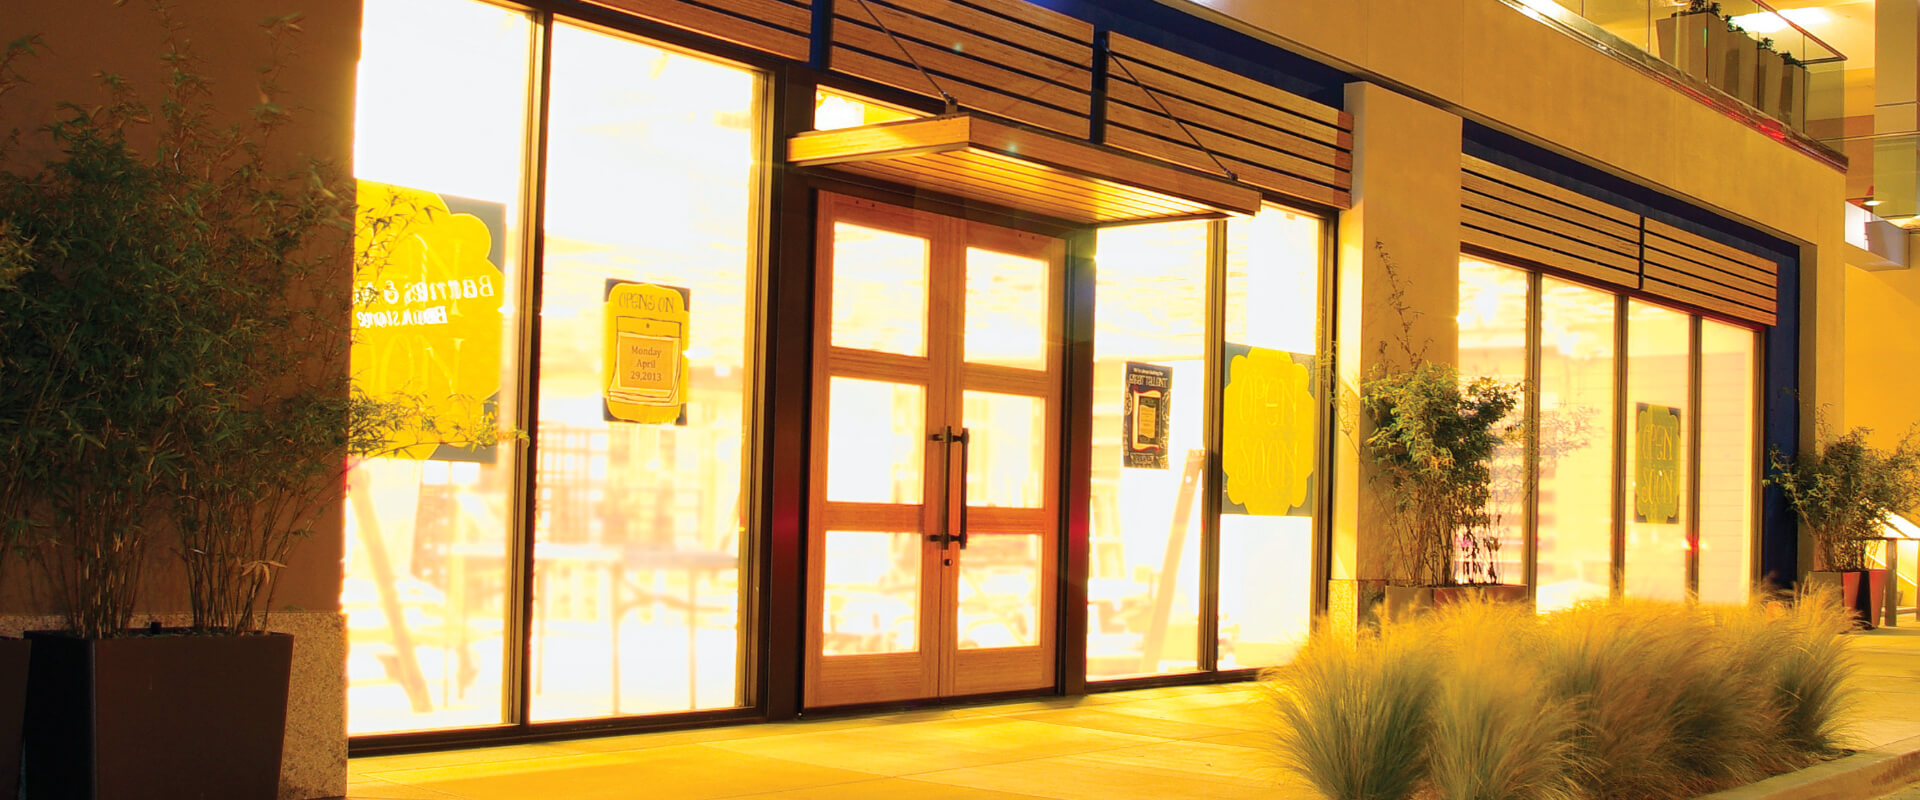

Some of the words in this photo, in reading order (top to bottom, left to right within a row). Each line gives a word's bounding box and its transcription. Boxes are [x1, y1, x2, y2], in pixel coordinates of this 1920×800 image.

[618, 292, 655, 311] OPENS
[657, 297, 674, 313] ON
[631, 346, 662, 358] Monday
[636, 359, 656, 369] April
[630, 370, 662, 381] 29,2013
[1239, 376, 1298, 425] OPEN
[1642, 423, 1673, 461] OPEN
[1236, 438, 1299, 489] SOON
[1641, 468, 1673, 505] SOON
